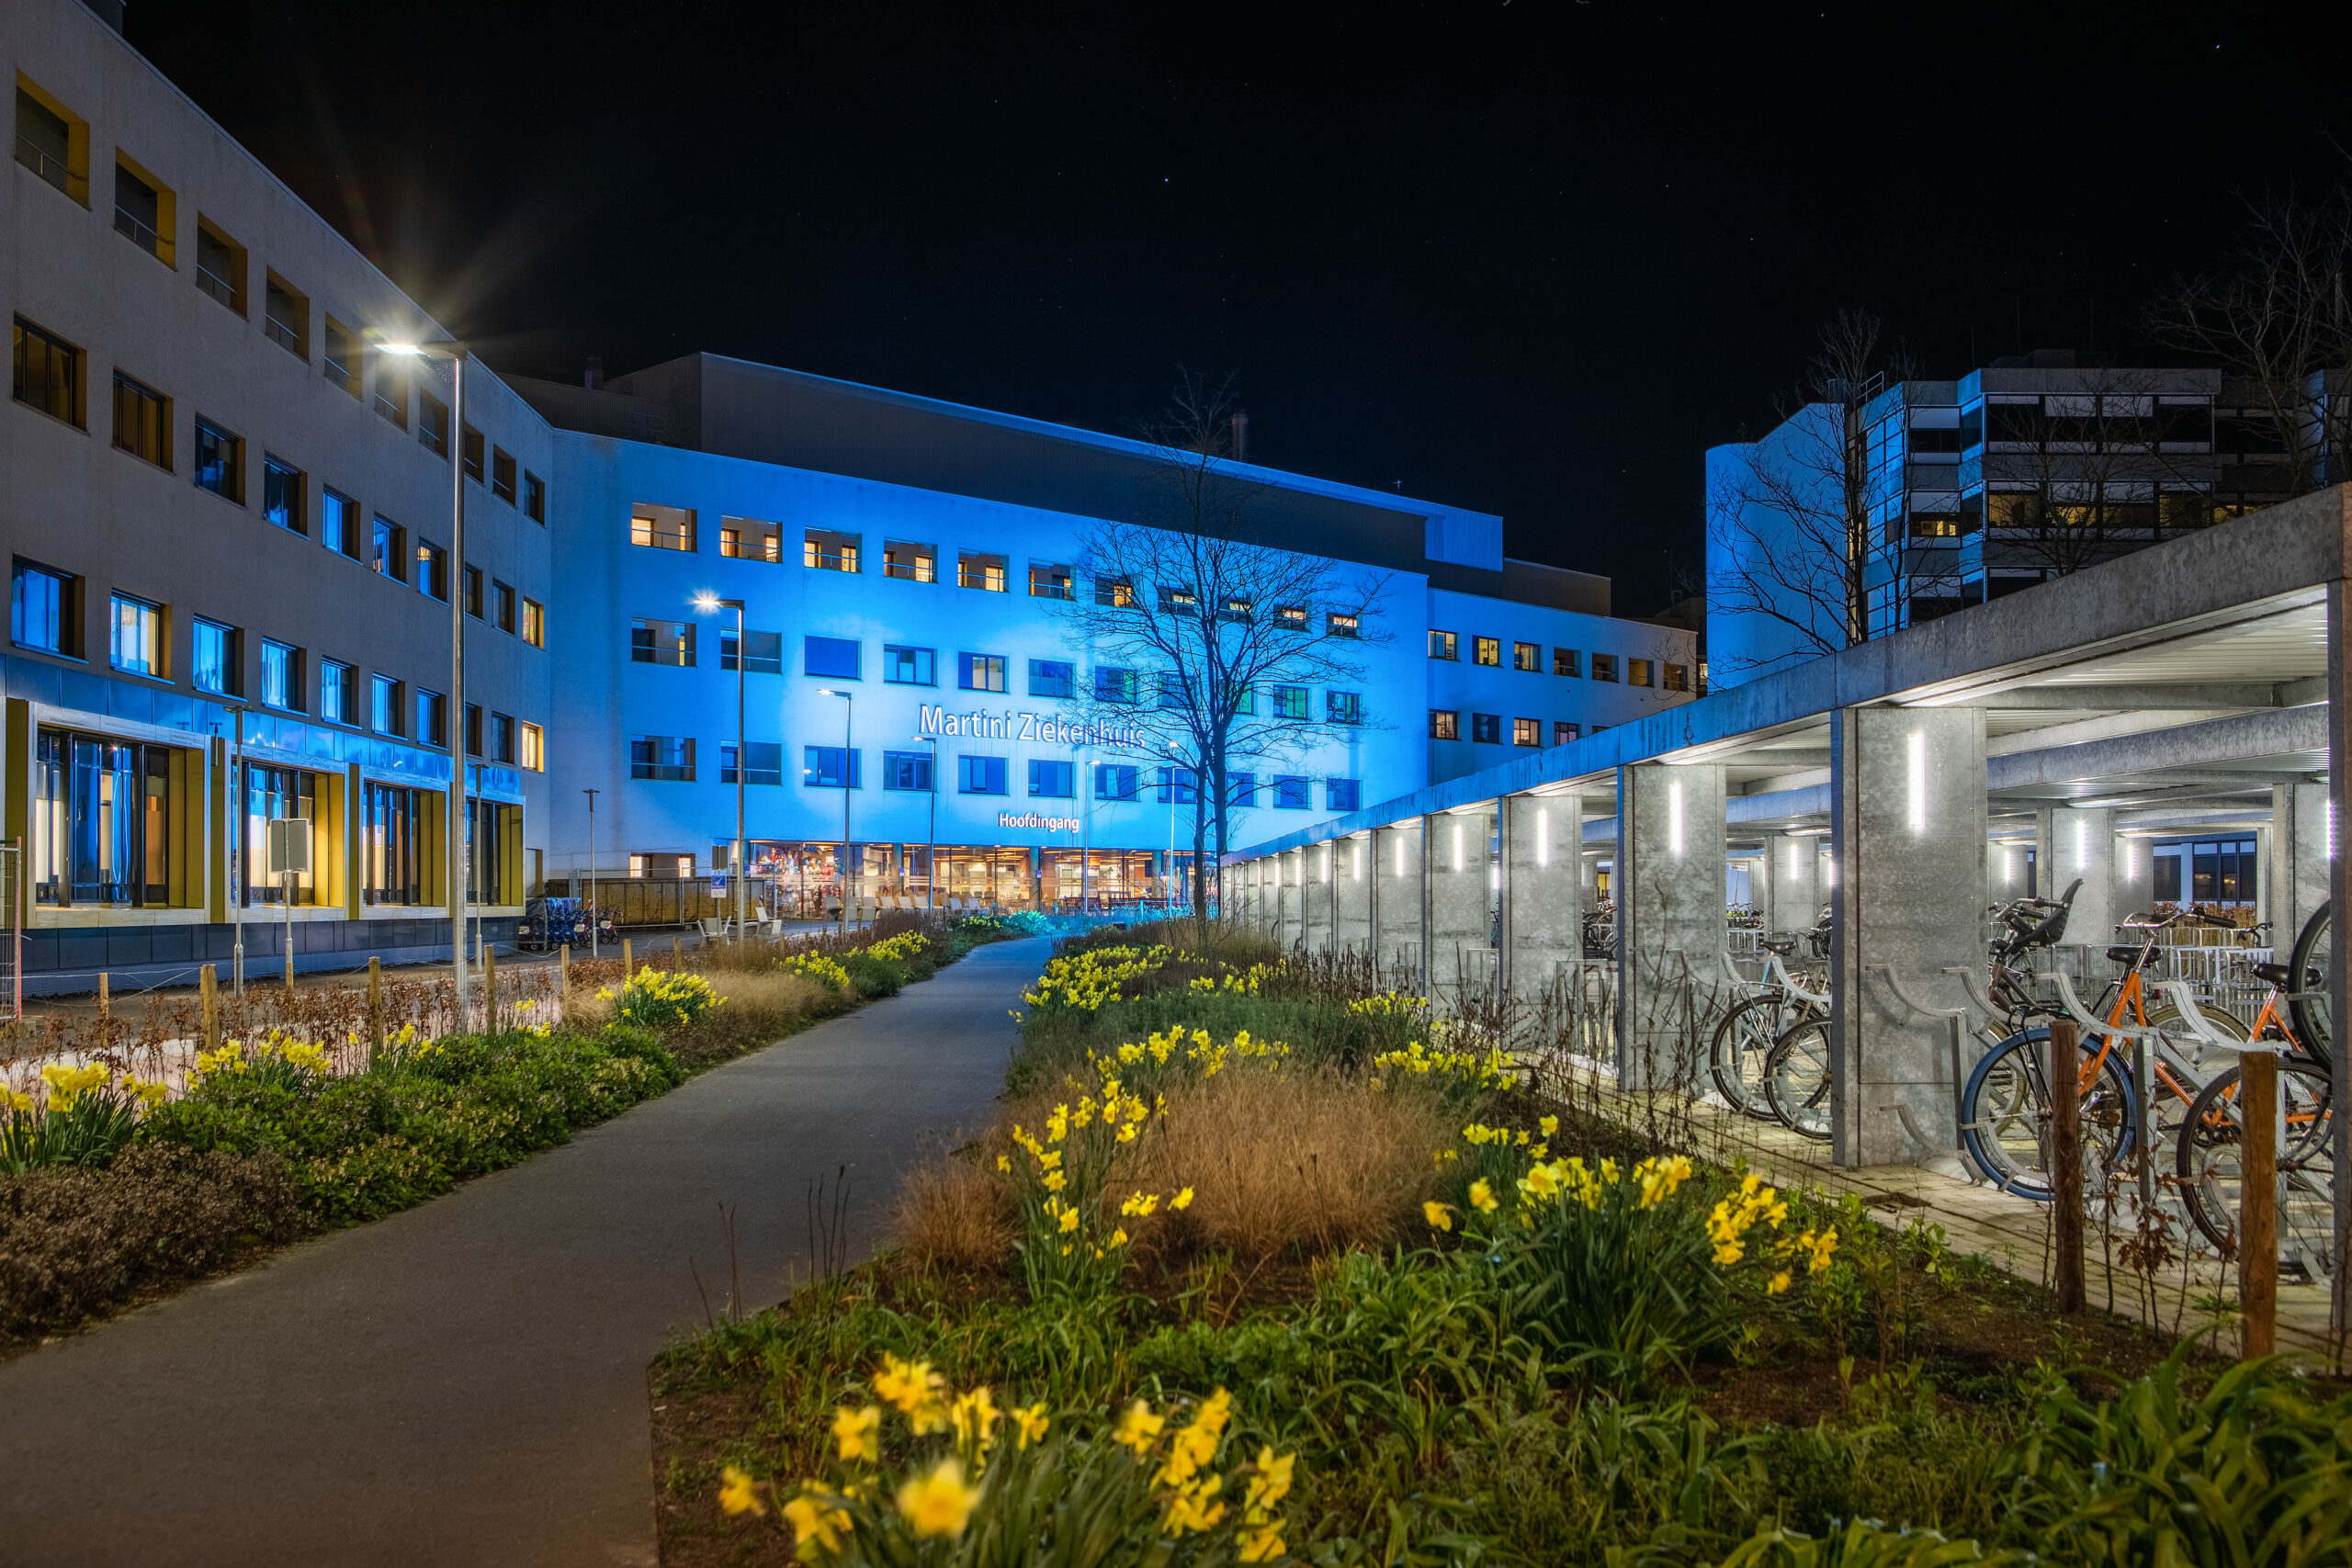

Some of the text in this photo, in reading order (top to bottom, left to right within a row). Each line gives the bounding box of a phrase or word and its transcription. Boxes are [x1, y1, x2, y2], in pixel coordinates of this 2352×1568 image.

[919, 705, 1146, 748] Martini Ziekenhuis
[998, 812, 1079, 833] Hoofdingang
